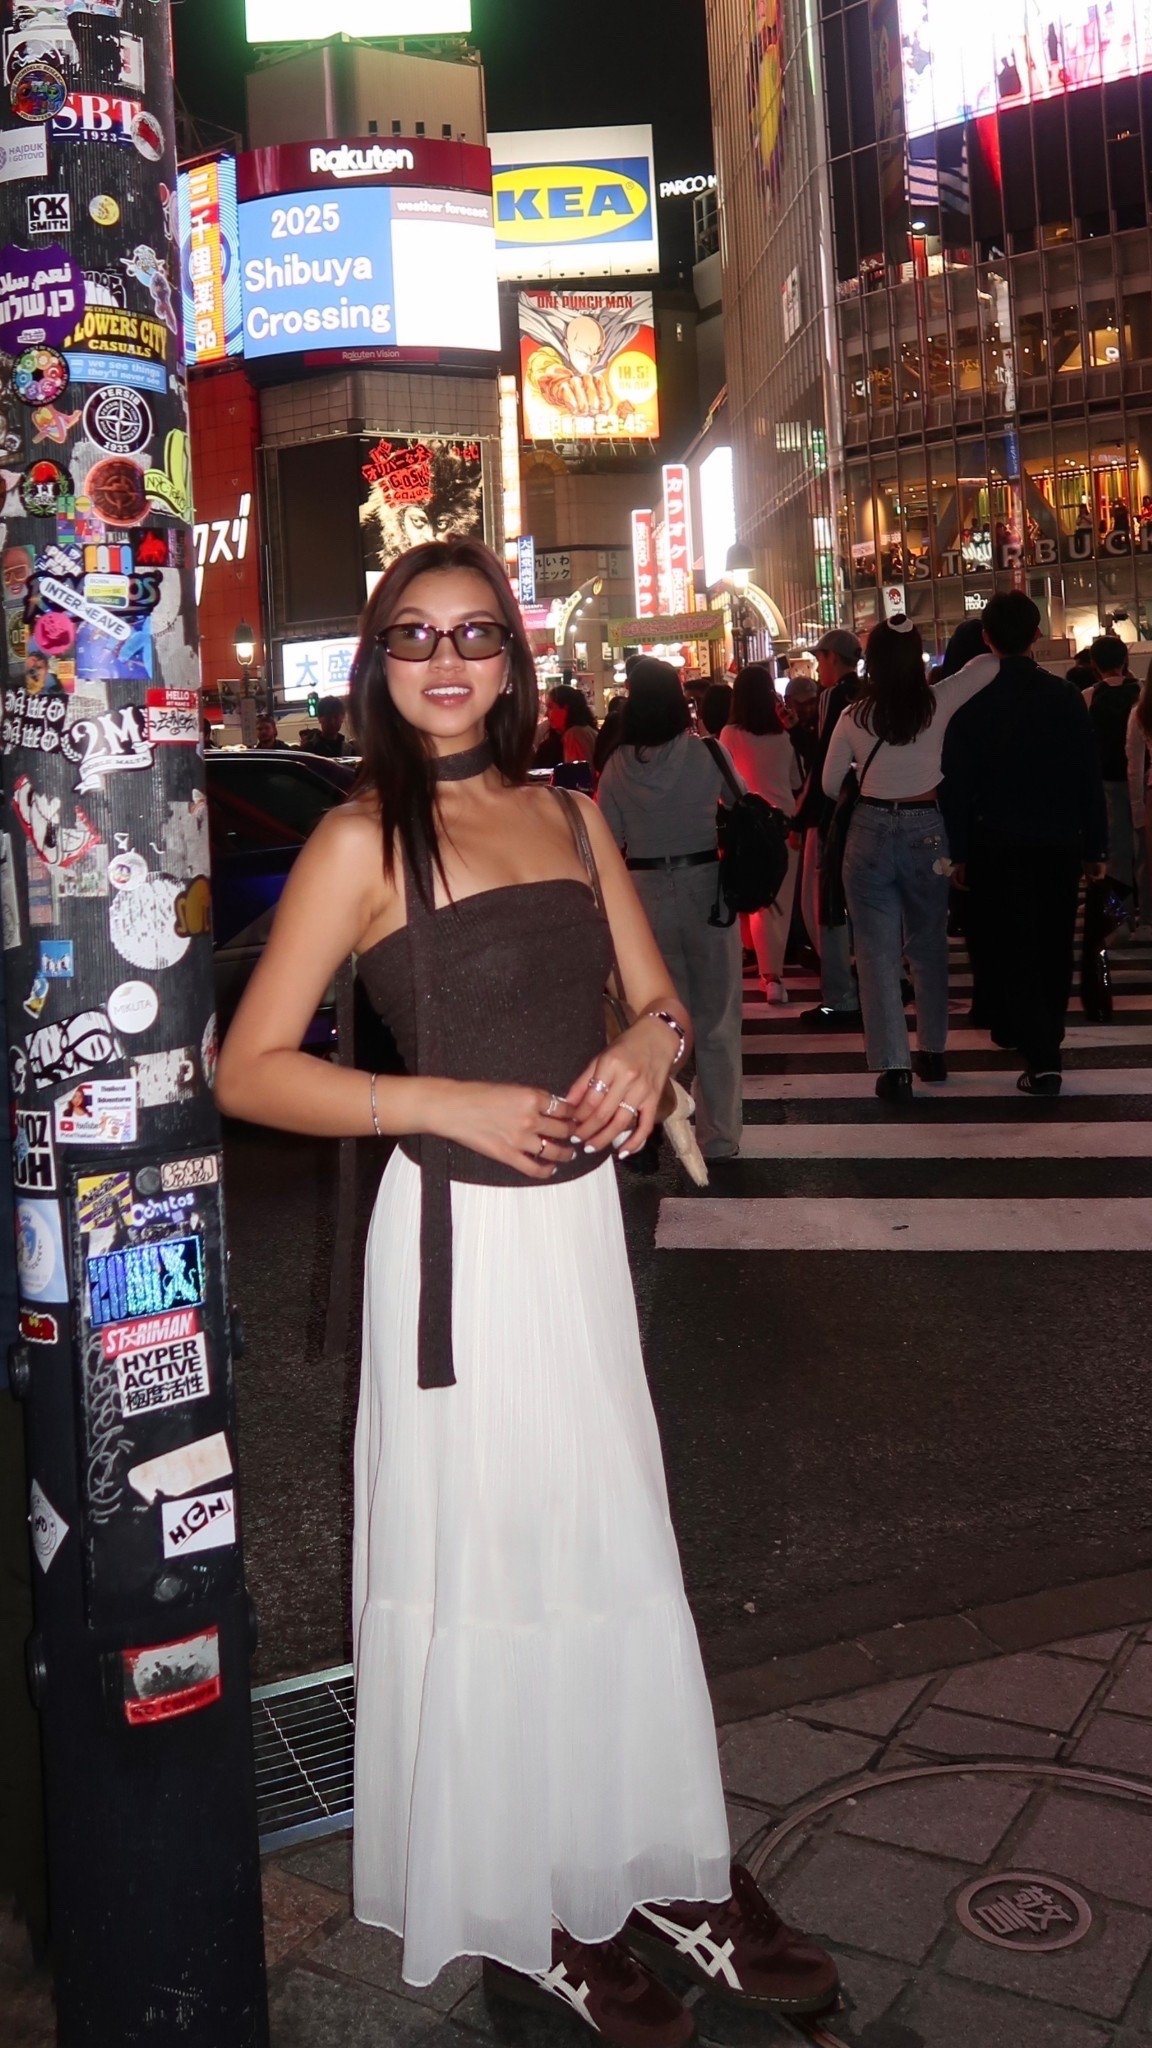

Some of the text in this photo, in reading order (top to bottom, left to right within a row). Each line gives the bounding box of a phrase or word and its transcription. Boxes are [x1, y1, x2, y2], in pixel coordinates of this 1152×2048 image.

[52, 95, 140, 135] SBT
[9, 143, 44, 155] HAJDUK
[83, 131, 118, 142] 1923
[13, 151, 45, 162] GOTOVO
[310, 144, 414, 175] Rakuten
[659, 175, 707, 198] PARCO
[397, 200, 489, 219] weather forecast
[496, 184, 634, 221] KEA
[30, 221, 68, 231] SMITH
[271, 203, 339, 239] 2025
[245, 253, 372, 293] Shibuya
[0, 292, 45, 325] שלו
[537, 295, 633, 309] ONE PUNCH MAN
[248, 297, 392, 340] Crossing
[64, 312, 138, 348] LOWERS
[140, 321, 167, 360] CITY
[88, 339, 151, 358] CASUALS
[88, 360, 160, 377] we see things
[342, 349, 400, 361] Rakuten Vision
[88, 368, 118, 377] they'll
[120, 372, 144, 382] never
[100, 388, 140, 406] PERSIB
[103, 441, 130, 453] 1933
[667, 477, 686, 560] カラオケ
[915, 527, 1152, 579] STRBUC
[166, 690, 190, 701] HELLO
[71, 706, 140, 761] 2M
[122, 1340, 198, 1373] HYPER
[124, 1355, 202, 1392] ACTIVE
[126, 1373, 205, 1413] 極度活性
